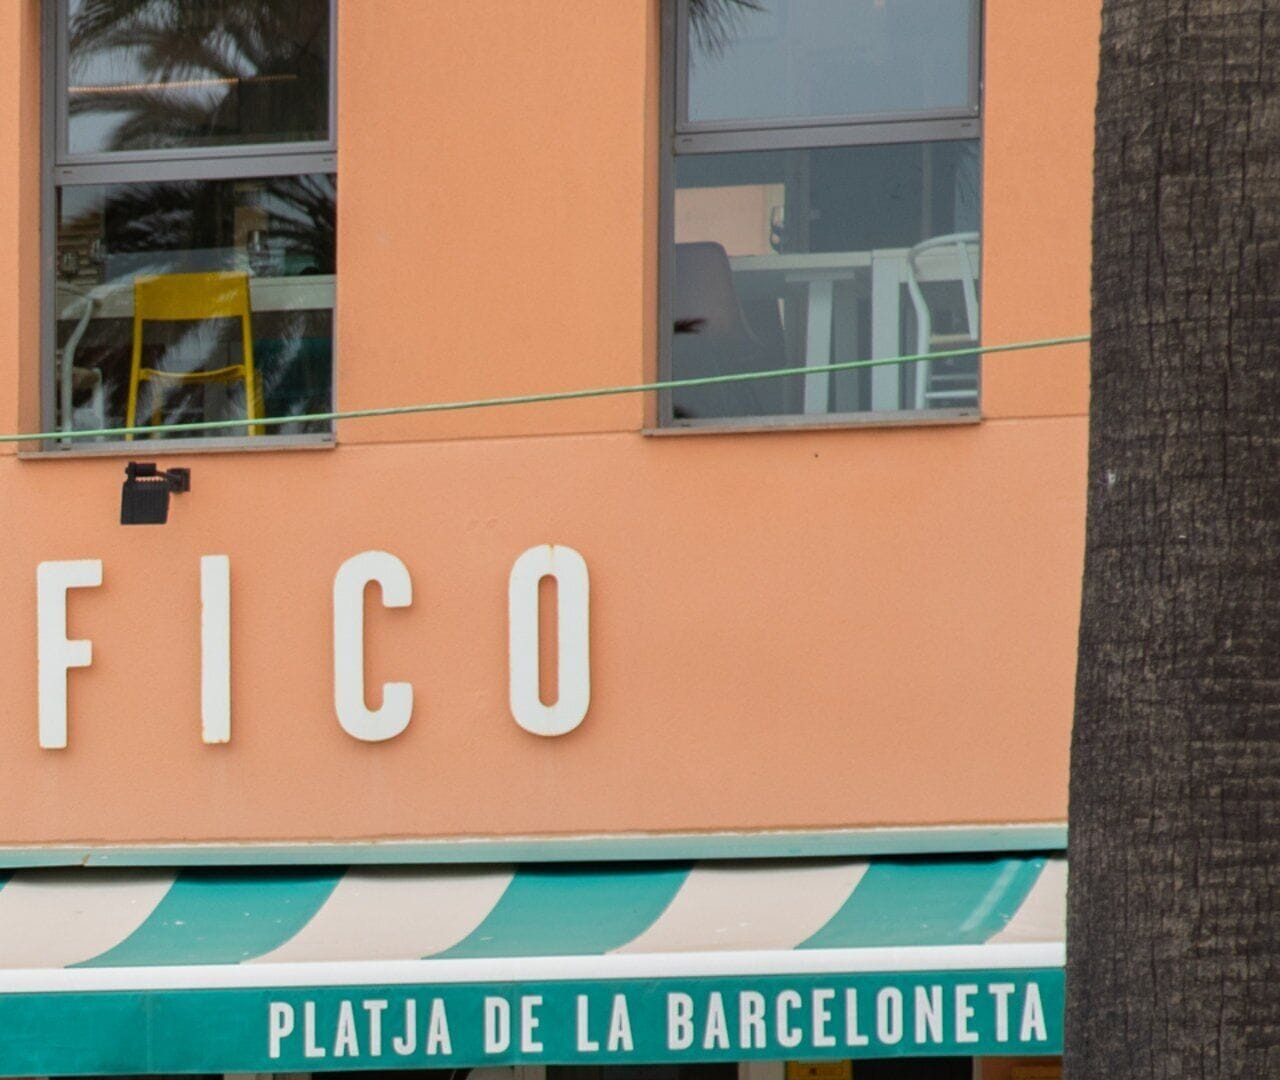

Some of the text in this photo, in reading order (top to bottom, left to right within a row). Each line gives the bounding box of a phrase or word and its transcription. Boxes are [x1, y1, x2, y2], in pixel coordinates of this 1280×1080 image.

[268, 982, 1049, 1058] PLATJA DE LA BARCELONETA
